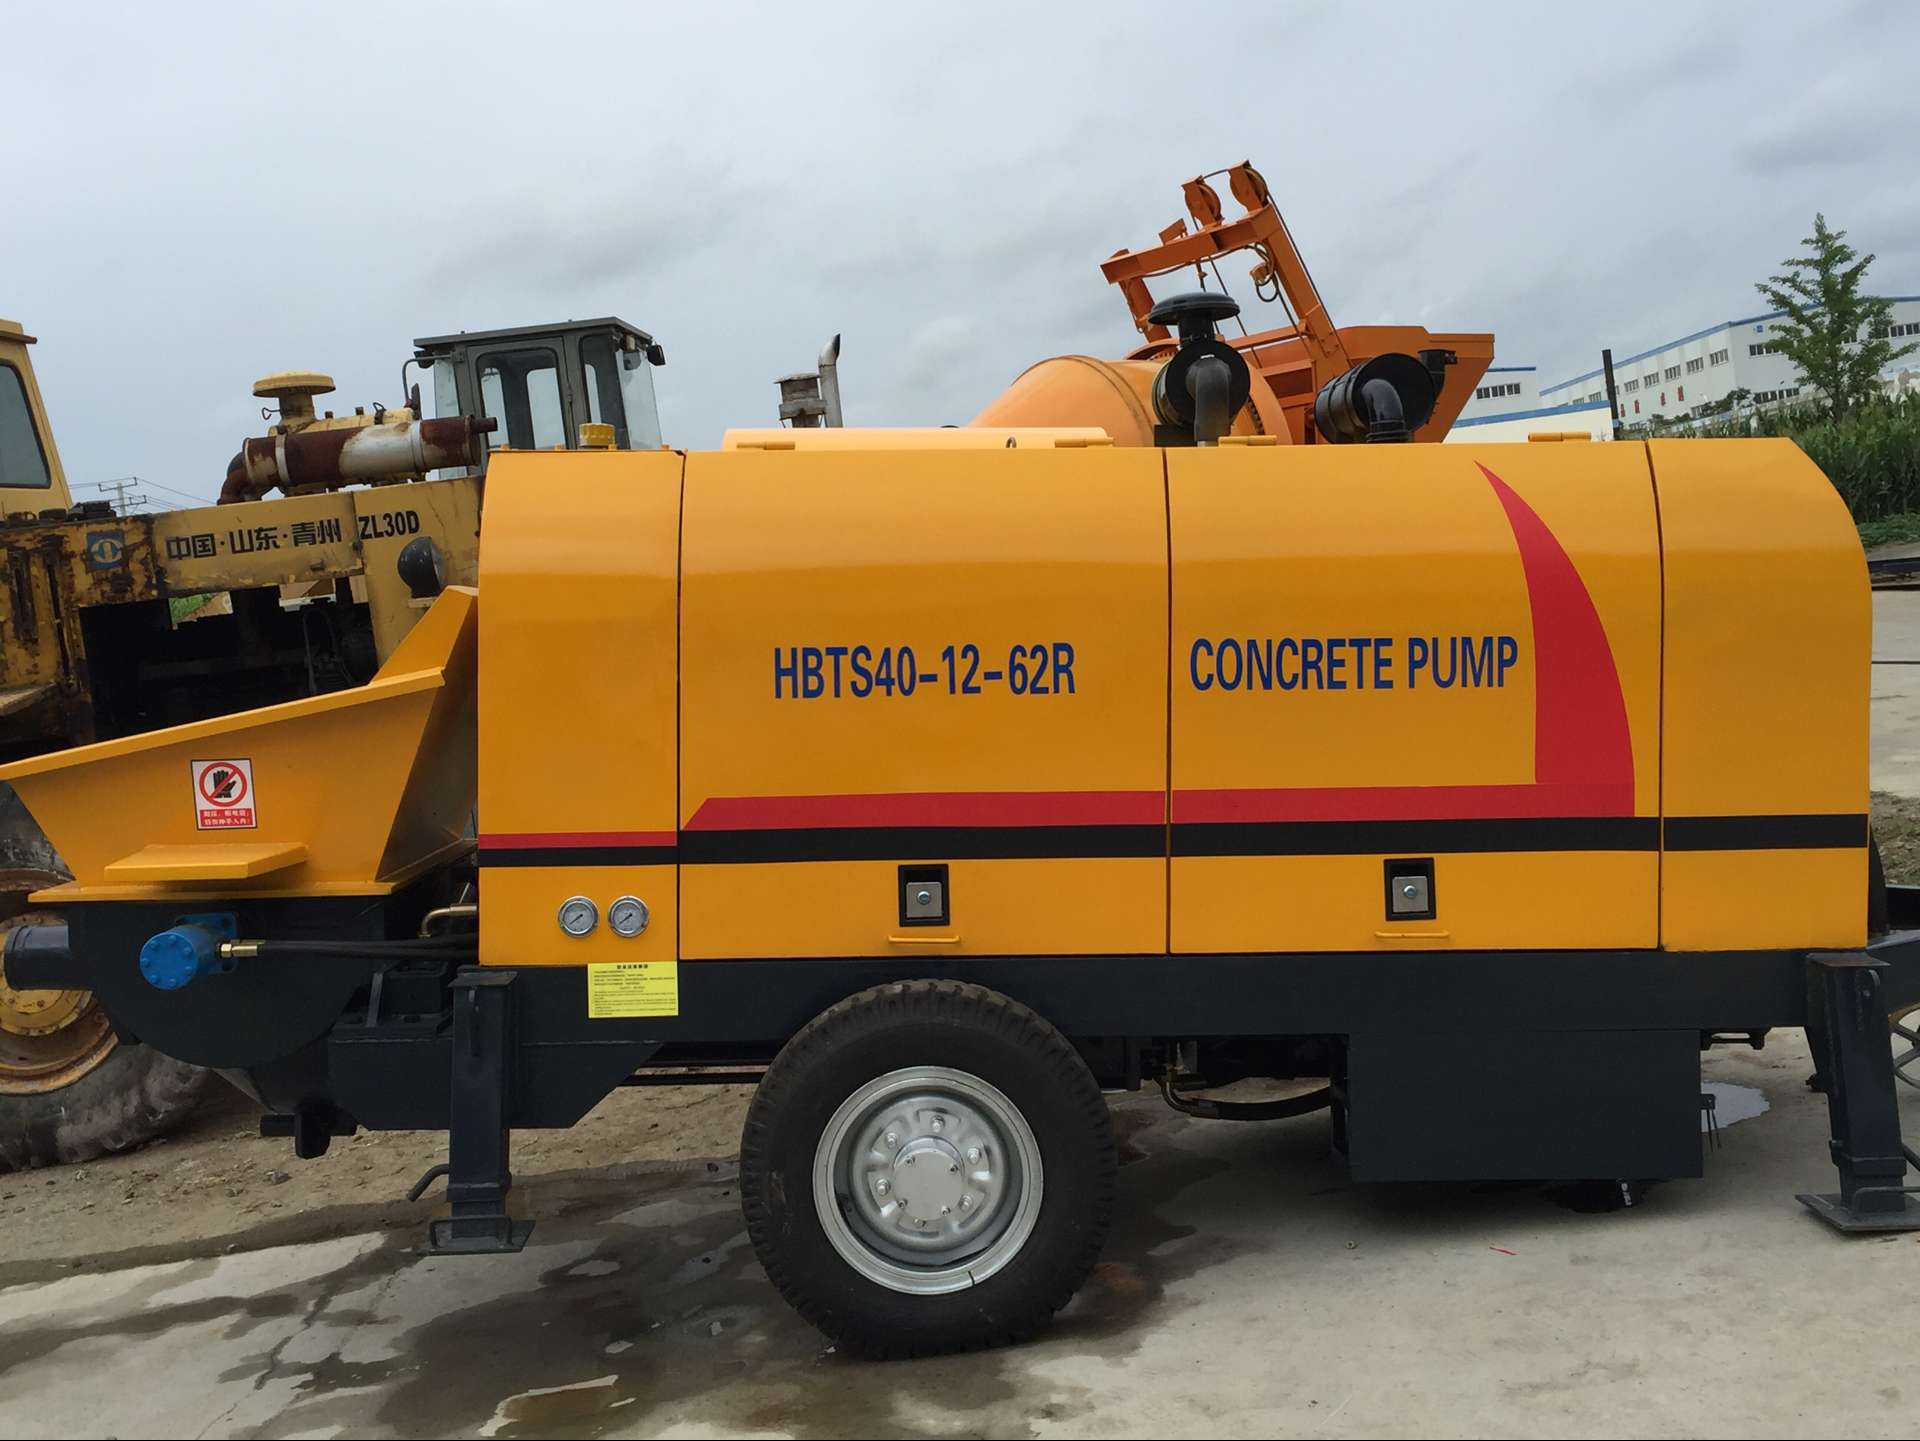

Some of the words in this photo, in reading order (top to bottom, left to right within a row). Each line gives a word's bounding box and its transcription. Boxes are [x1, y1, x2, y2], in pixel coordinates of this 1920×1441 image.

[358, 510, 420, 540] ZL30D
[774, 642, 1076, 699] HBTS40-12-62R
[1190, 637, 1394, 691] CONCRETE
[1408, 635, 1518, 689] PUMP
